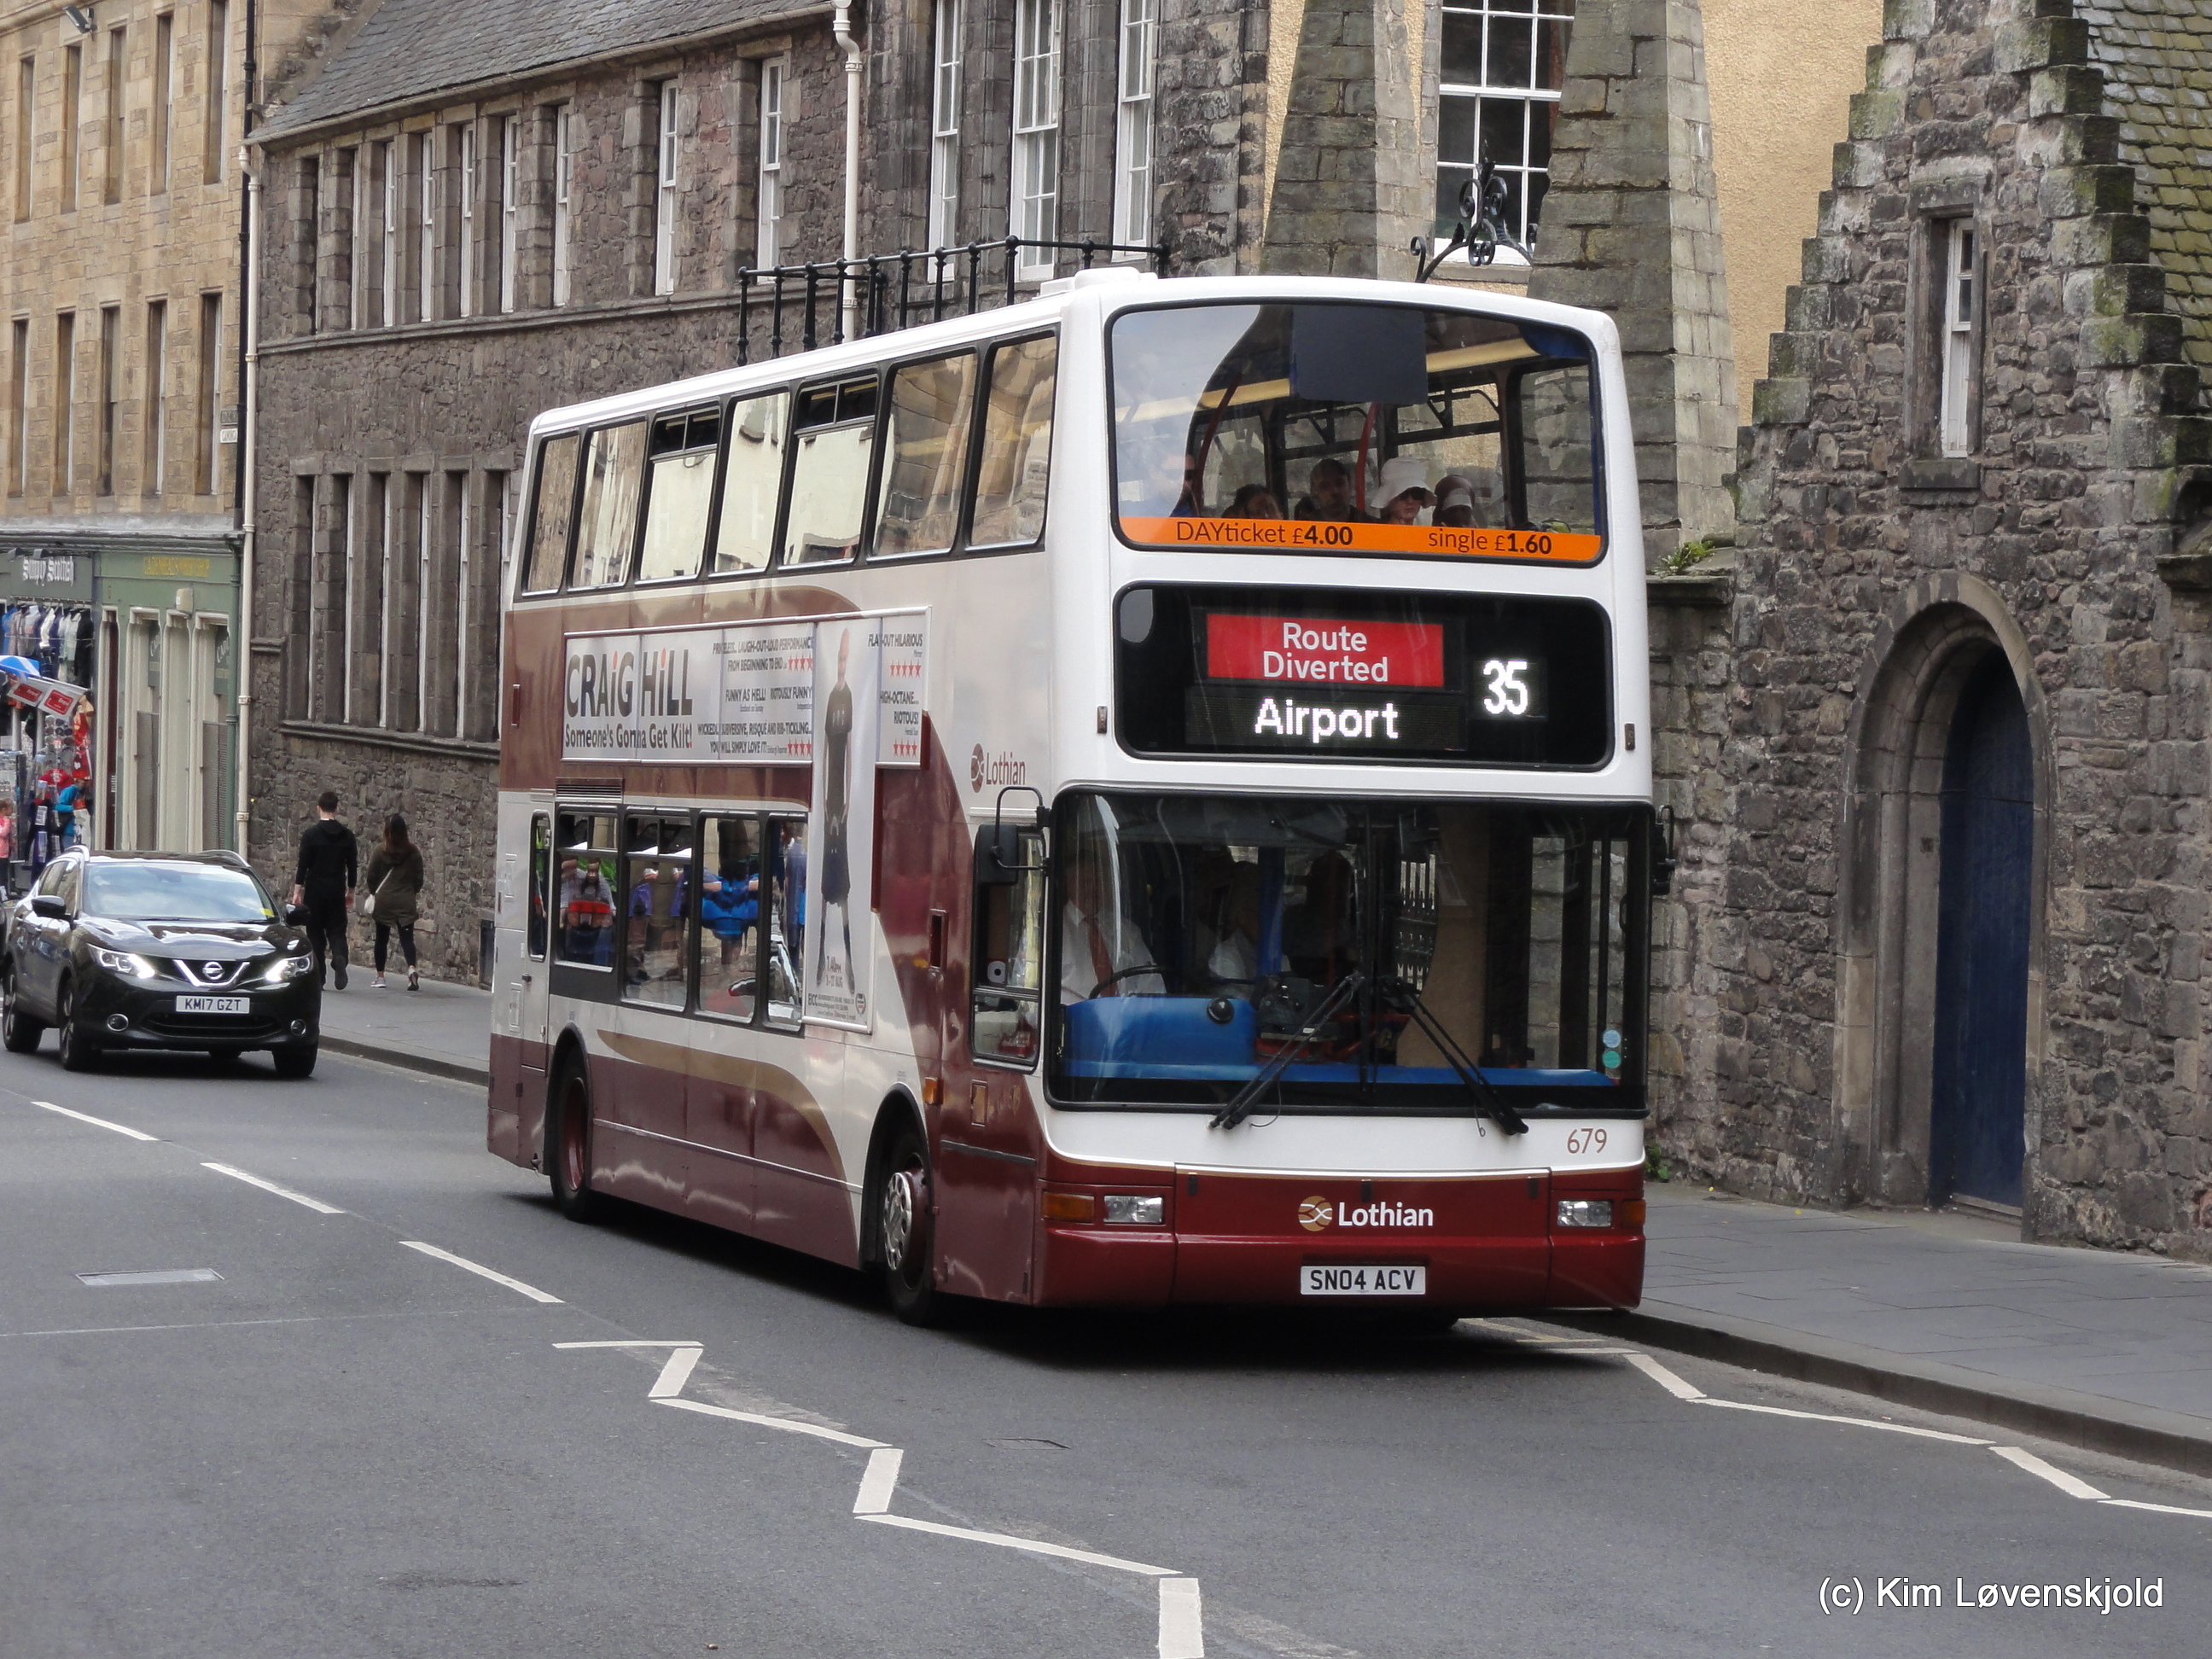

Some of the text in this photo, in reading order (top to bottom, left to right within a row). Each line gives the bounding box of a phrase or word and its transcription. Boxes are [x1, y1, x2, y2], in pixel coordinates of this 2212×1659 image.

[1176, 521, 1353, 546] DAYticket £4.00
[1428, 528, 1552, 555] single £1.60
[894, 632, 923, 647] HILARIOUS
[1283, 622, 1367, 652] Route
[740, 658, 768, 672] BEGINNING
[1263, 650, 1388, 683] Diverted
[725, 689, 742, 702] FUNNY
[742, 688, 750, 701] AS
[1481, 660, 1529, 716] 35
[1254, 698, 1399, 743] Airport
[565, 722, 692, 748] Someone's Gonna Get Kilt!
[748, 741, 760, 754] LOVE
[987, 751, 1026, 785] Lothian
[184, 998, 242, 1011] KM17 GZT
[1567, 1128, 1608, 1155] 679
[1338, 1202, 1434, 1227] Lothian
[1310, 1269, 1416, 1290] SN04 ACV
